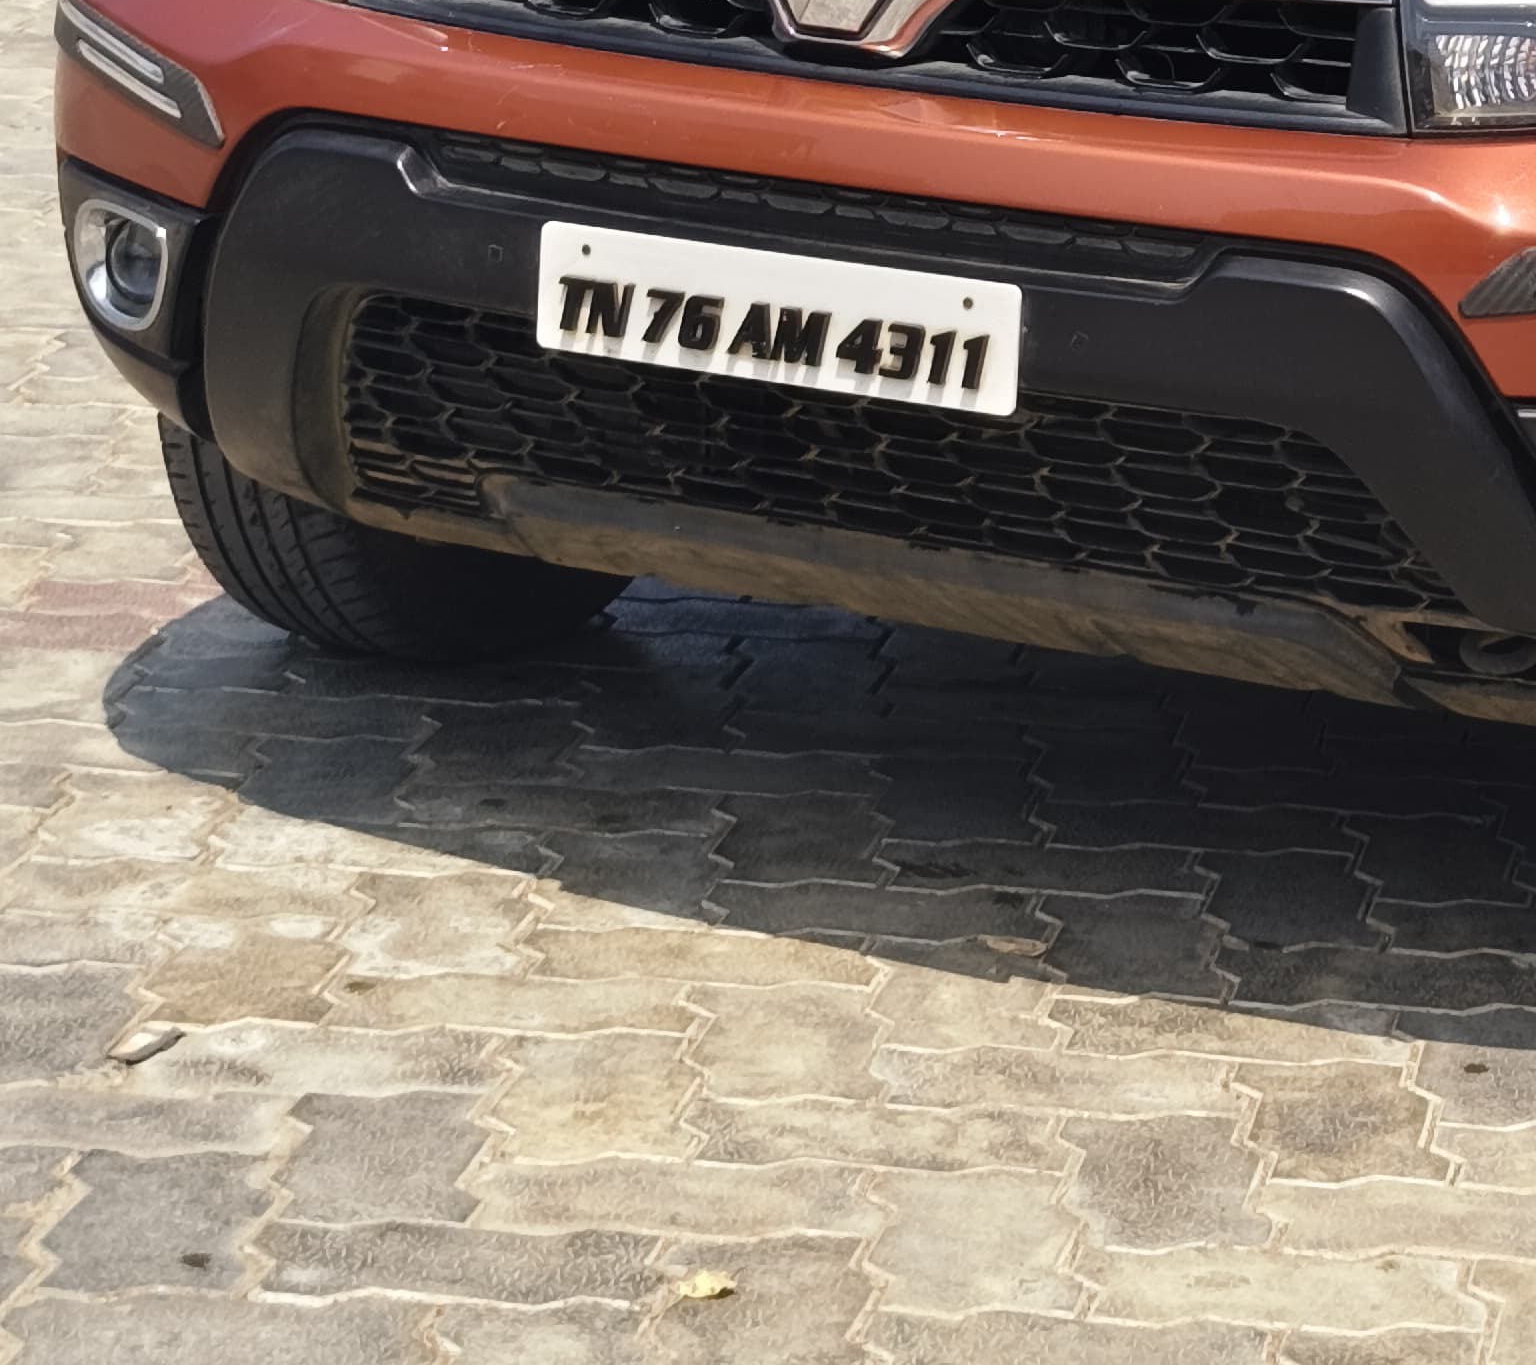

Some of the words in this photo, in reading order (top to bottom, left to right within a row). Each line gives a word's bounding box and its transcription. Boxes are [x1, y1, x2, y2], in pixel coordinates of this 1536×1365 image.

[558, 274, 635, 338] TN
[642, 288, 725, 351] 76
[727, 301, 832, 367] AM
[836, 318, 990, 390] 4311
